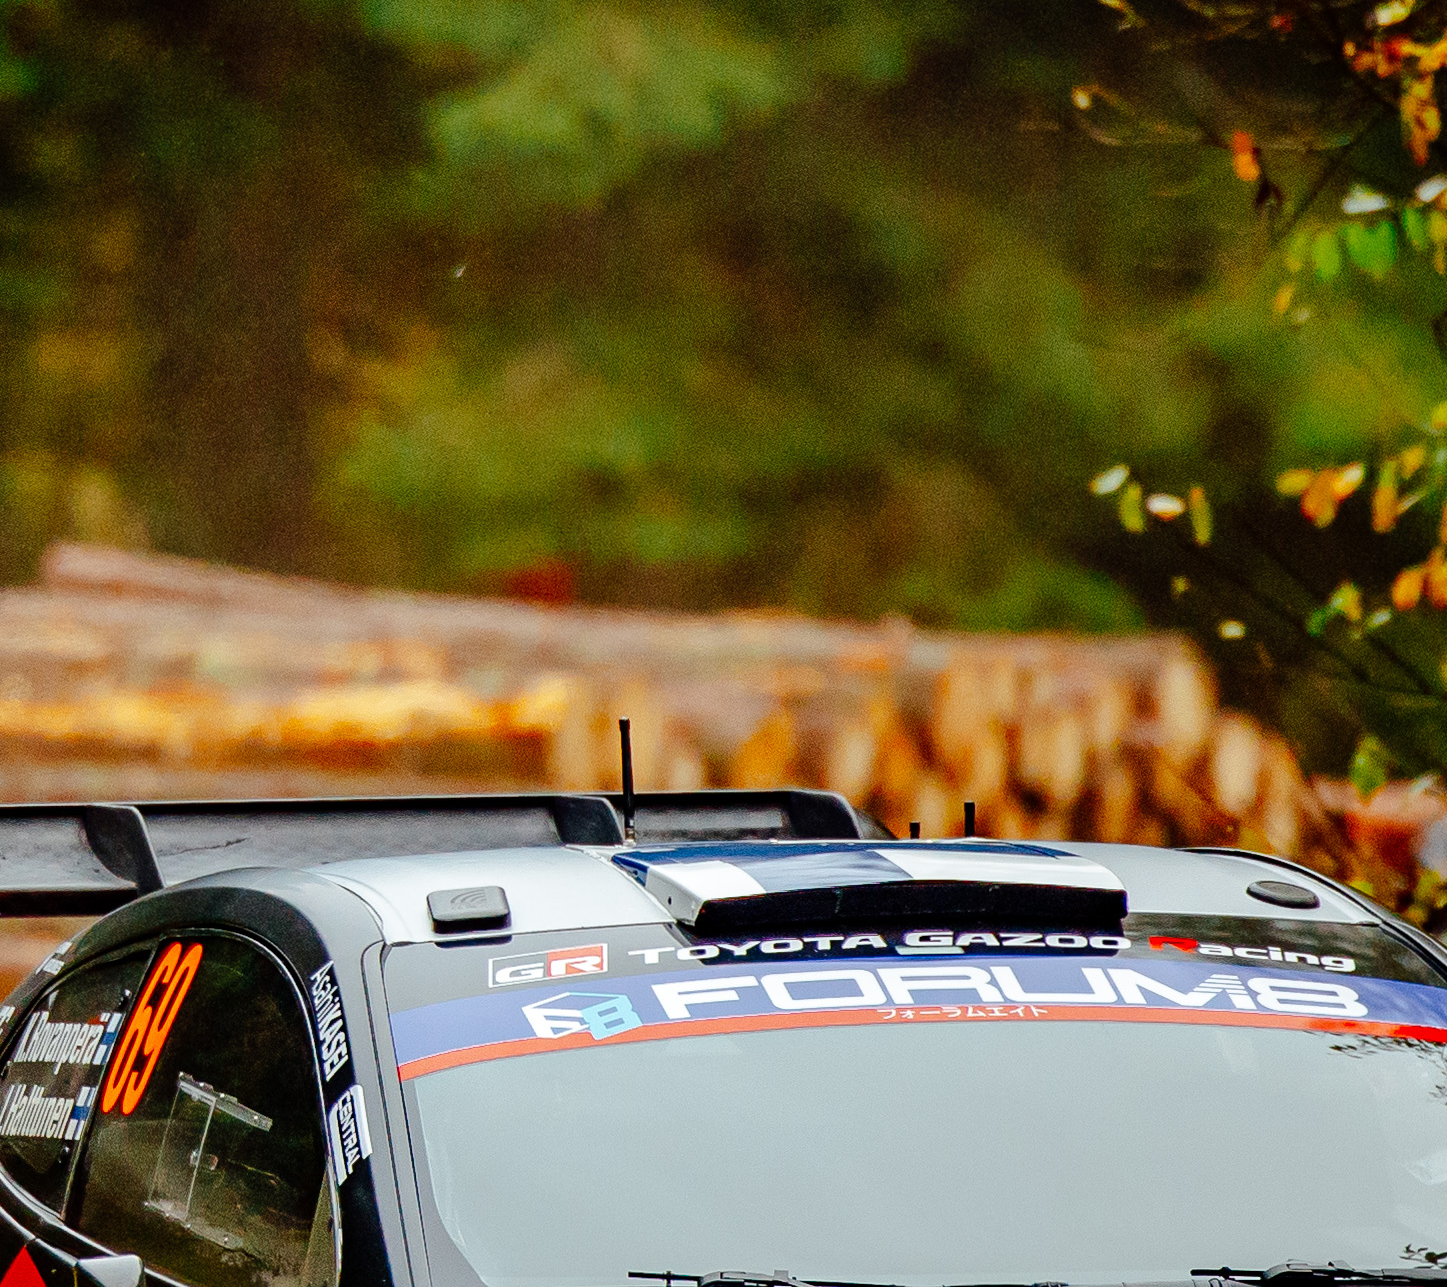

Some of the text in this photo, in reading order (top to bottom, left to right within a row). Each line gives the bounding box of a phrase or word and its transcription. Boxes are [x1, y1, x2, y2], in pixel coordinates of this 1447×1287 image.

[494, 929, 1358, 985] GR TOYOTA GAZOO Racing
[650, 964, 1369, 1020] FORUM8
[101, 941, 204, 1116] 69
[309, 960, 350, 1083] AsahiKASEI
[876, 1005, 1048, 1020] フォーラムエイト
[337, 1088, 361, 1176] CENTRAL
